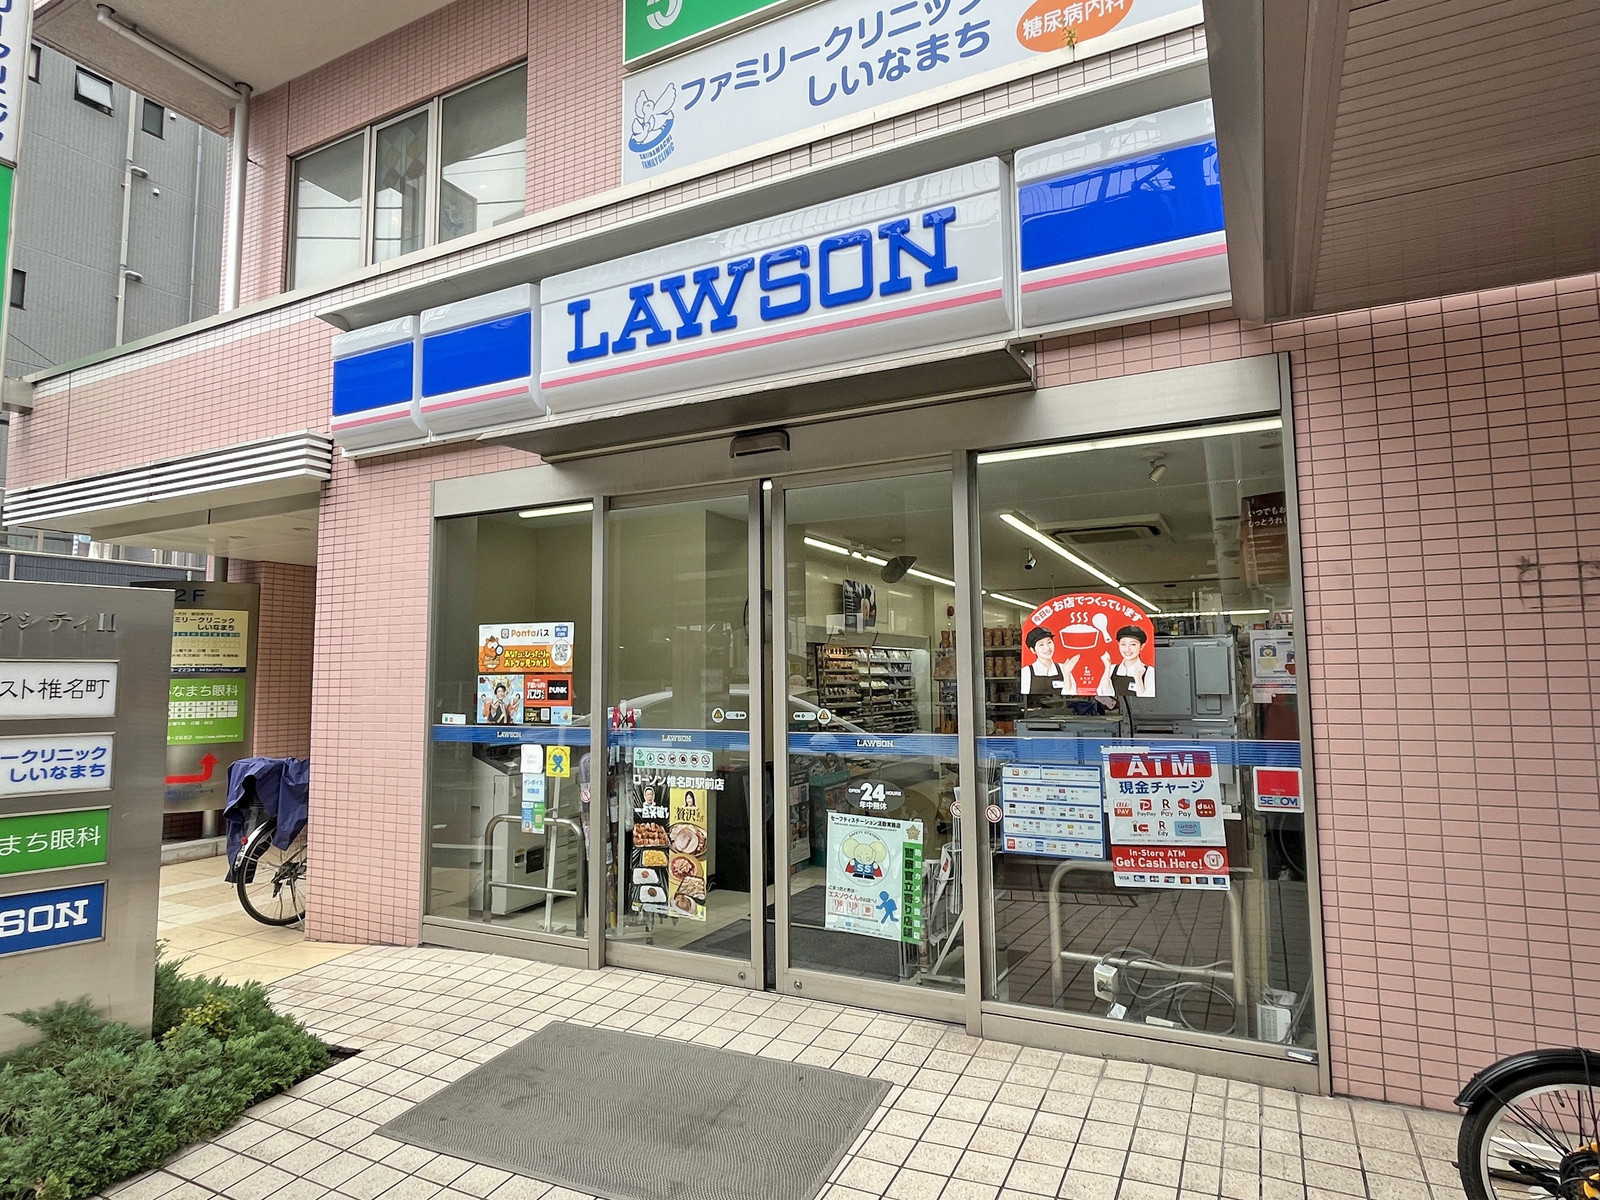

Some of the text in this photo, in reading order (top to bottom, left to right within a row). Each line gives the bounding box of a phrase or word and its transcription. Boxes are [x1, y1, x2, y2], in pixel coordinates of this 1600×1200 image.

[808, 19, 991, 107] しいなまち
[567, 206, 958, 363] LAWSON
[1053, 596, 1143, 622] お店でつくっています
[511, 628, 550, 638] Pontaパス
[0, 678, 110, 700] スト椎名町
[169, 684, 239, 697] なまち眼科
[661, 734, 692, 742] LAWSON
[856, 739, 894, 748] LAWSON
[1127, 754, 1195, 776] ATM
[10, 764, 105, 782] しいなまち
[632, 775, 725, 790] ローソン椎名町駅前店
[1119, 779, 1205, 795] 現金チャージ
[860, 782, 886, 801] 24
[859, 801, 888, 811] 年中無休
[1260, 796, 1297, 806] SECOM
[0, 825, 101, 856] まち眼科
[1129, 849, 1186, 858] In-Store ATM
[857, 864, 872, 873] SS
[1116, 857, 1203, 869] Get Cash Here!
[0, 899, 89, 937] SON
